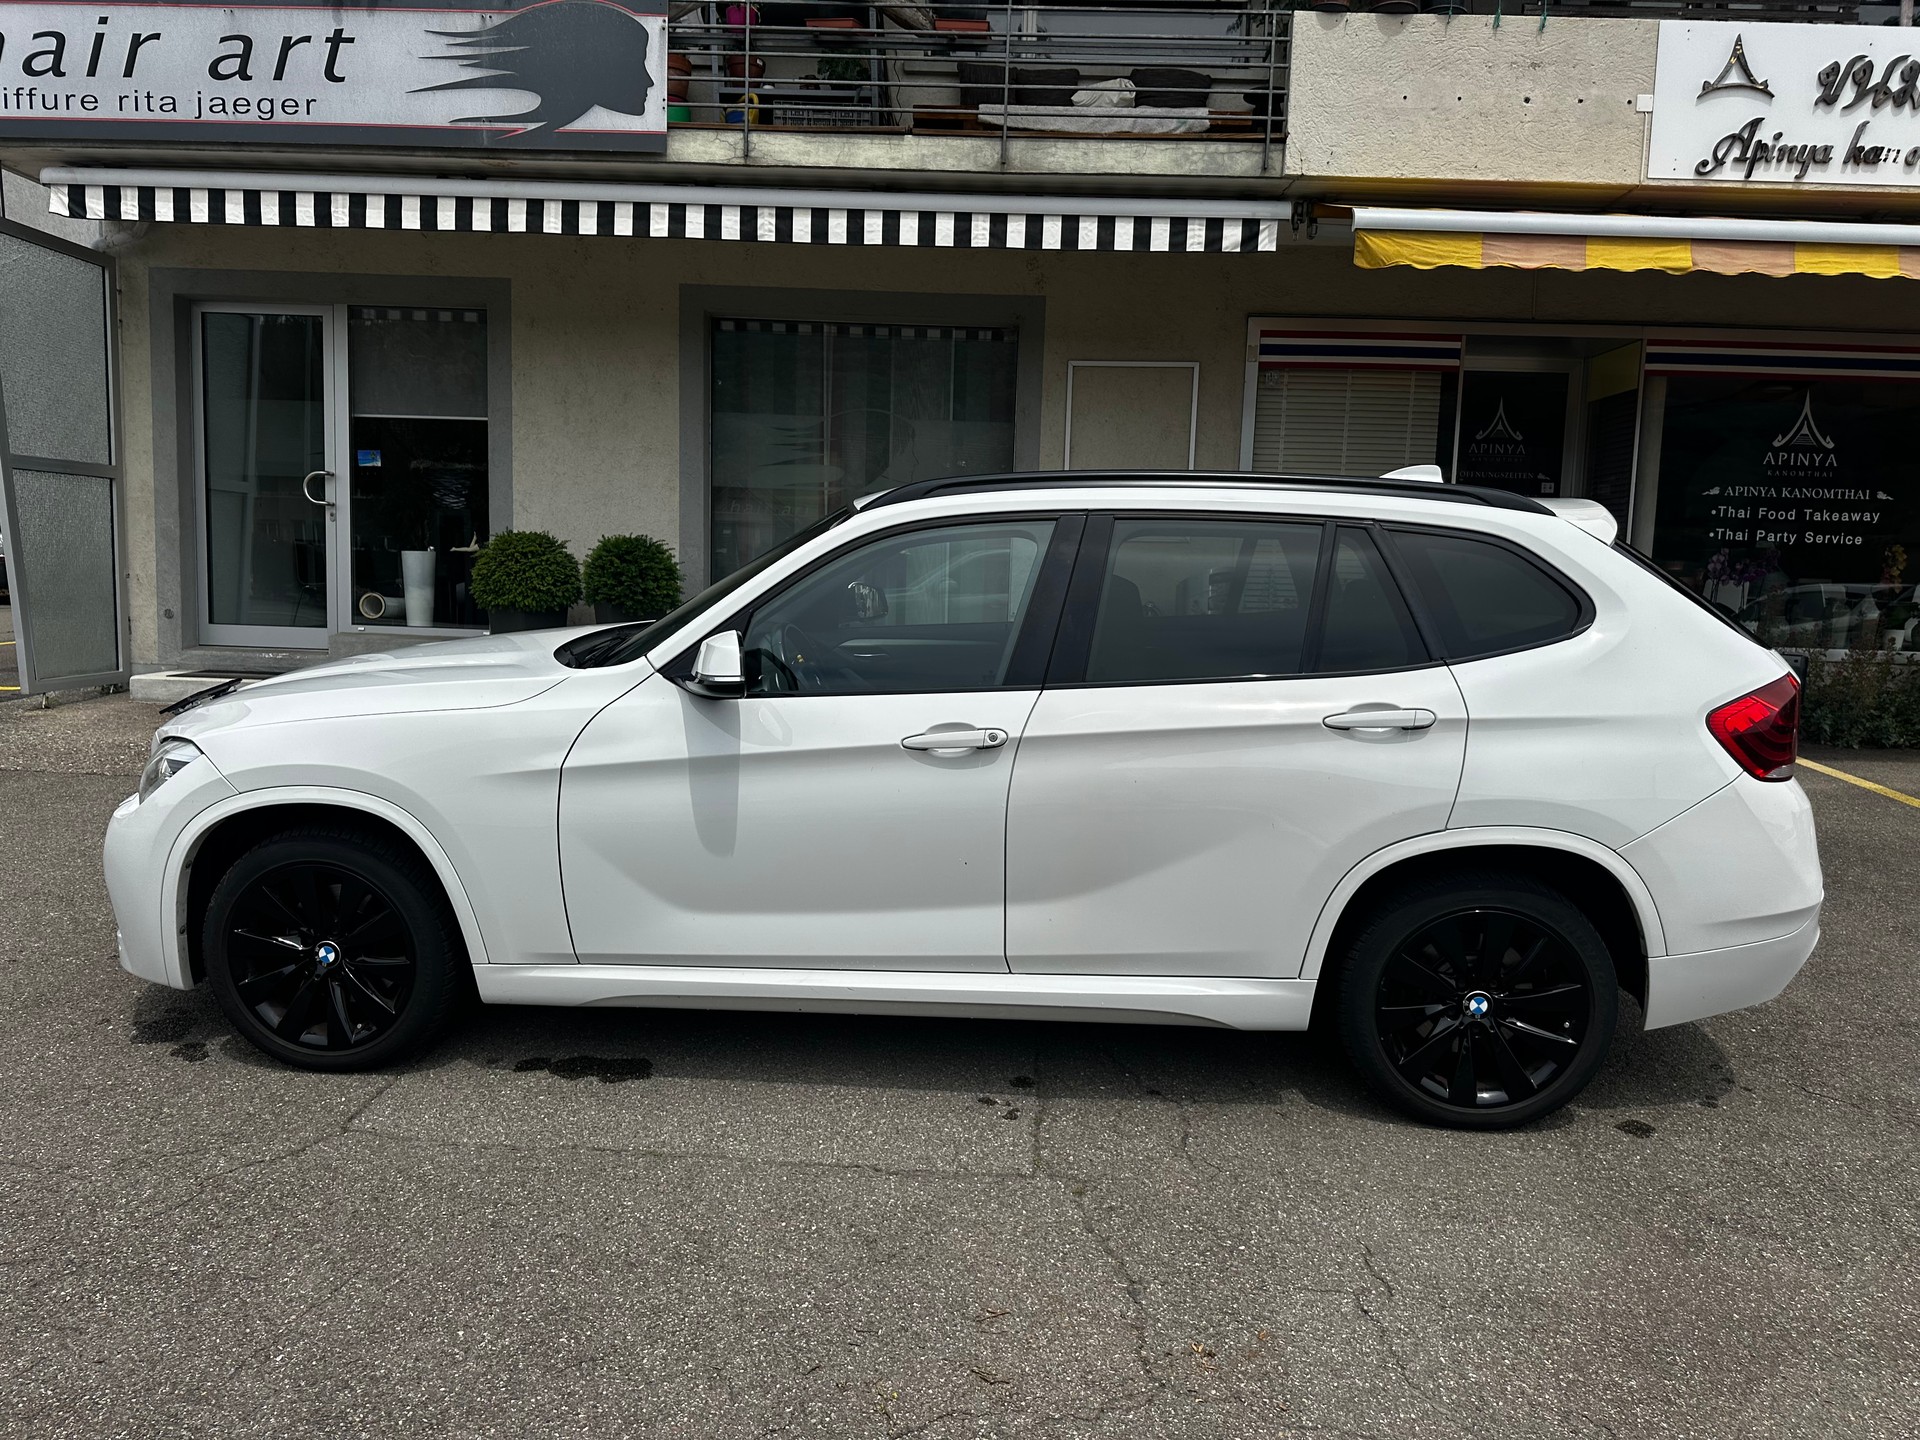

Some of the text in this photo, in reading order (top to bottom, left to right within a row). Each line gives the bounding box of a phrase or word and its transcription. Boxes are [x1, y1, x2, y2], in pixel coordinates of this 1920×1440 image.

[0, 16, 356, 83] air art
[118, 90, 178, 113] rita
[194, 91, 317, 121] jaeger
[1694, 117, 1834, 179] Apinya
[1468, 443, 1526, 455] APINYA
[1763, 451, 1838, 467] APINYA
[1767, 469, 1833, 478] KANOMTHAI
[1724, 486, 1871, 500] APINYA KANOMTHAI
[1758, 507, 1796, 521] Food
[1804, 509, 1881, 524] Takeaway
[1756, 530, 1797, 545] Party
[1804, 532, 1863, 545] Service
